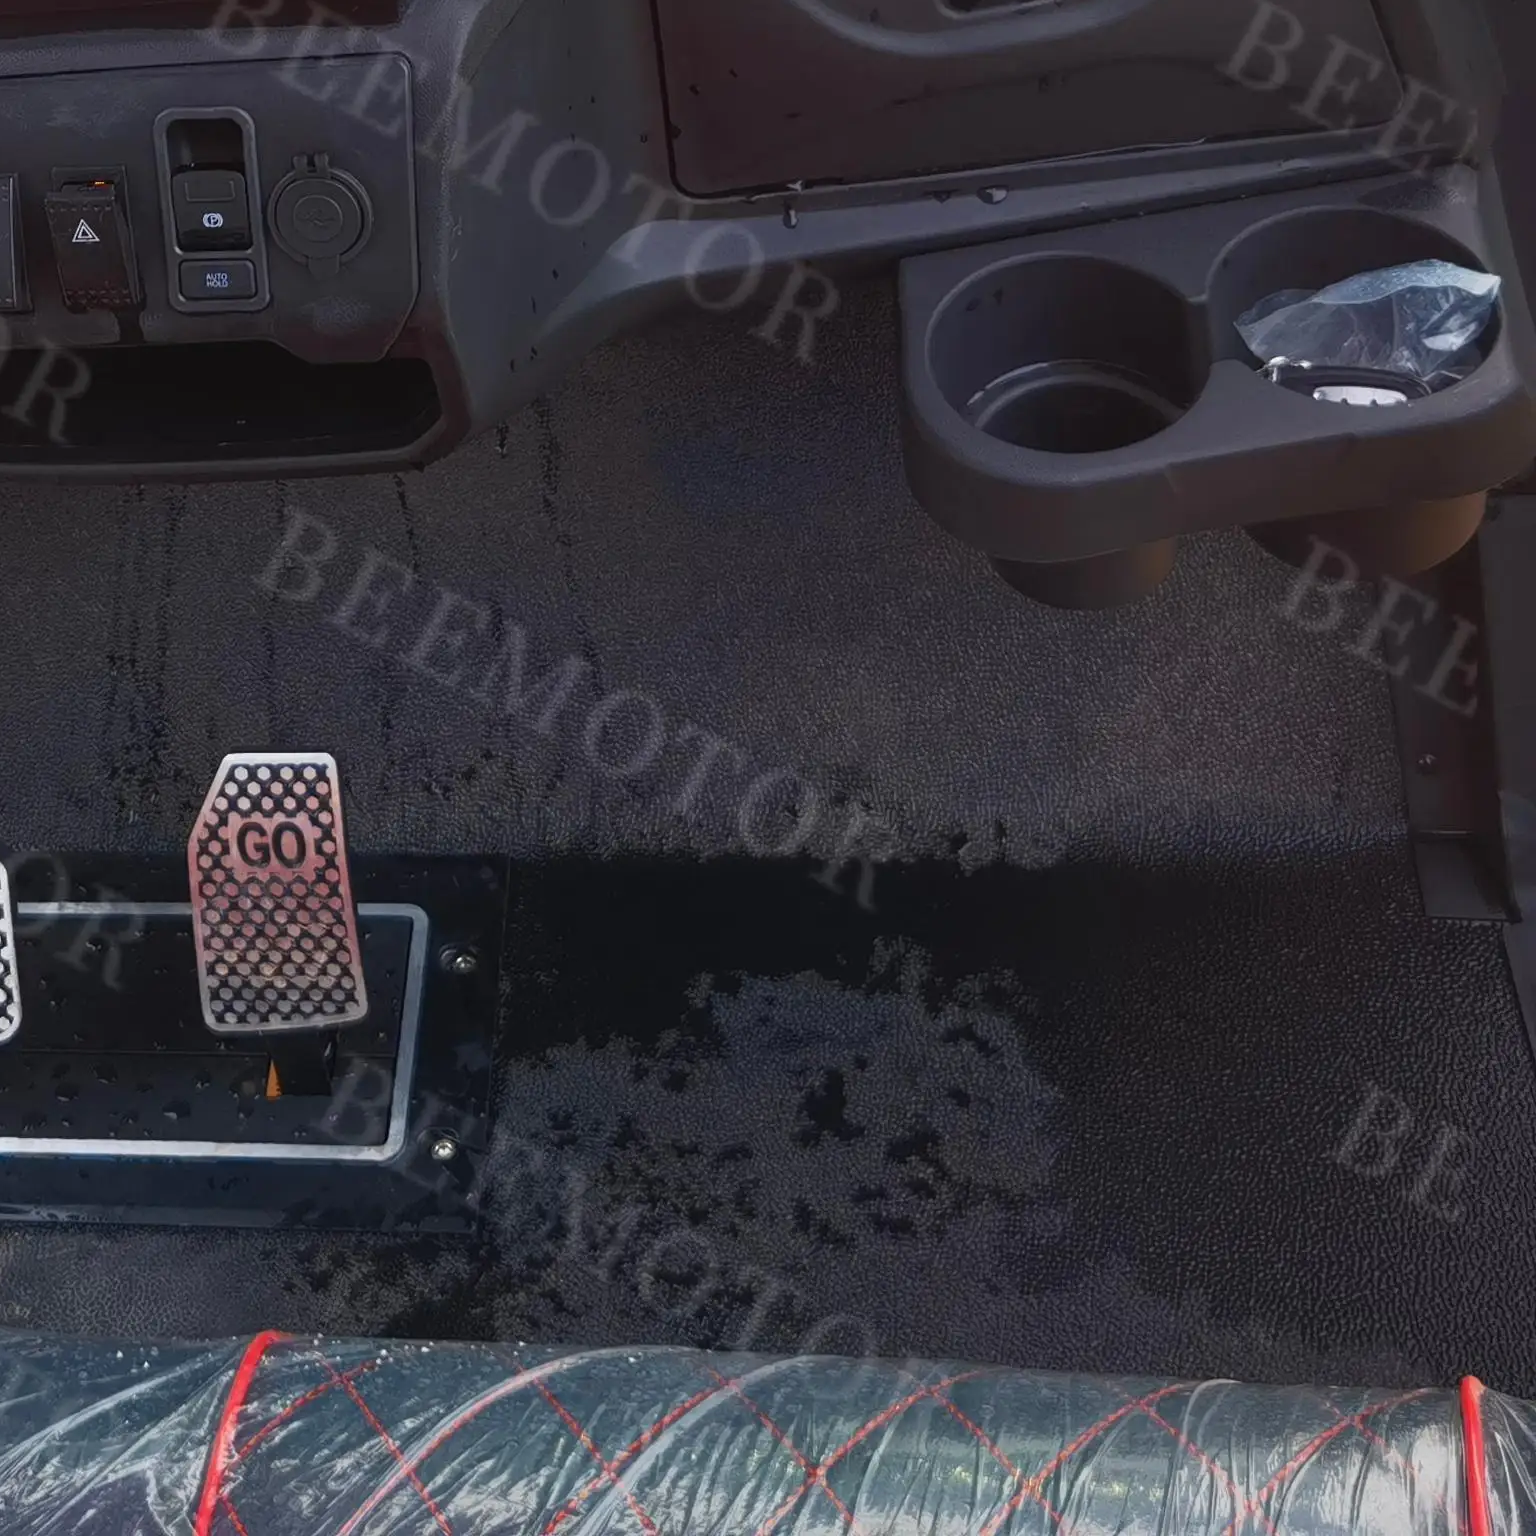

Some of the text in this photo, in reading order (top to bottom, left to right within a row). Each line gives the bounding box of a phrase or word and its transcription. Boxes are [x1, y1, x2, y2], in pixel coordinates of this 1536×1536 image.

[206, 272, 228, 281] AUTO
[206, 280, 229, 288] HOLD
[236, 821, 308, 869] GO
